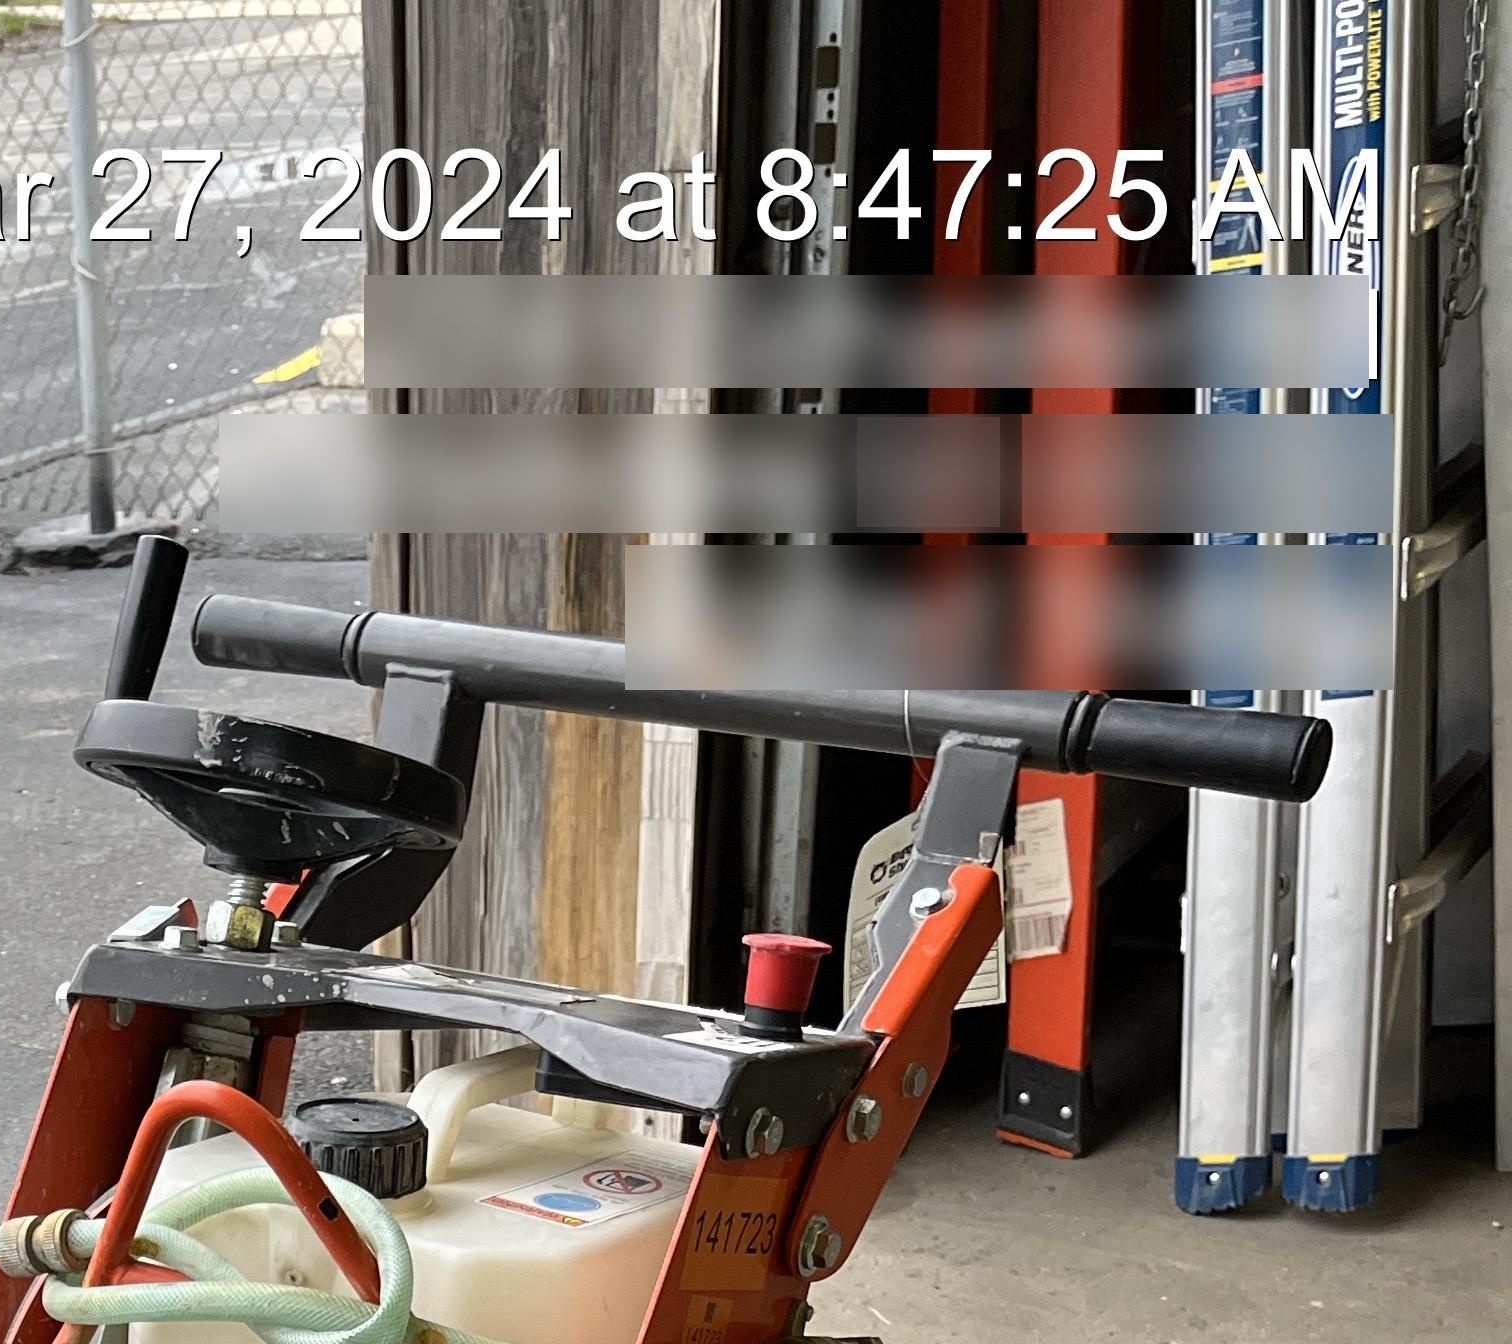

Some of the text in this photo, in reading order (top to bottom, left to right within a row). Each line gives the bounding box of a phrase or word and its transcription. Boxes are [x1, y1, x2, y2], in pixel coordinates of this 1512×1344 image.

[1367, 8, 1383, 122] with POWERLITE
[694, 1209, 777, 1254] 141723
